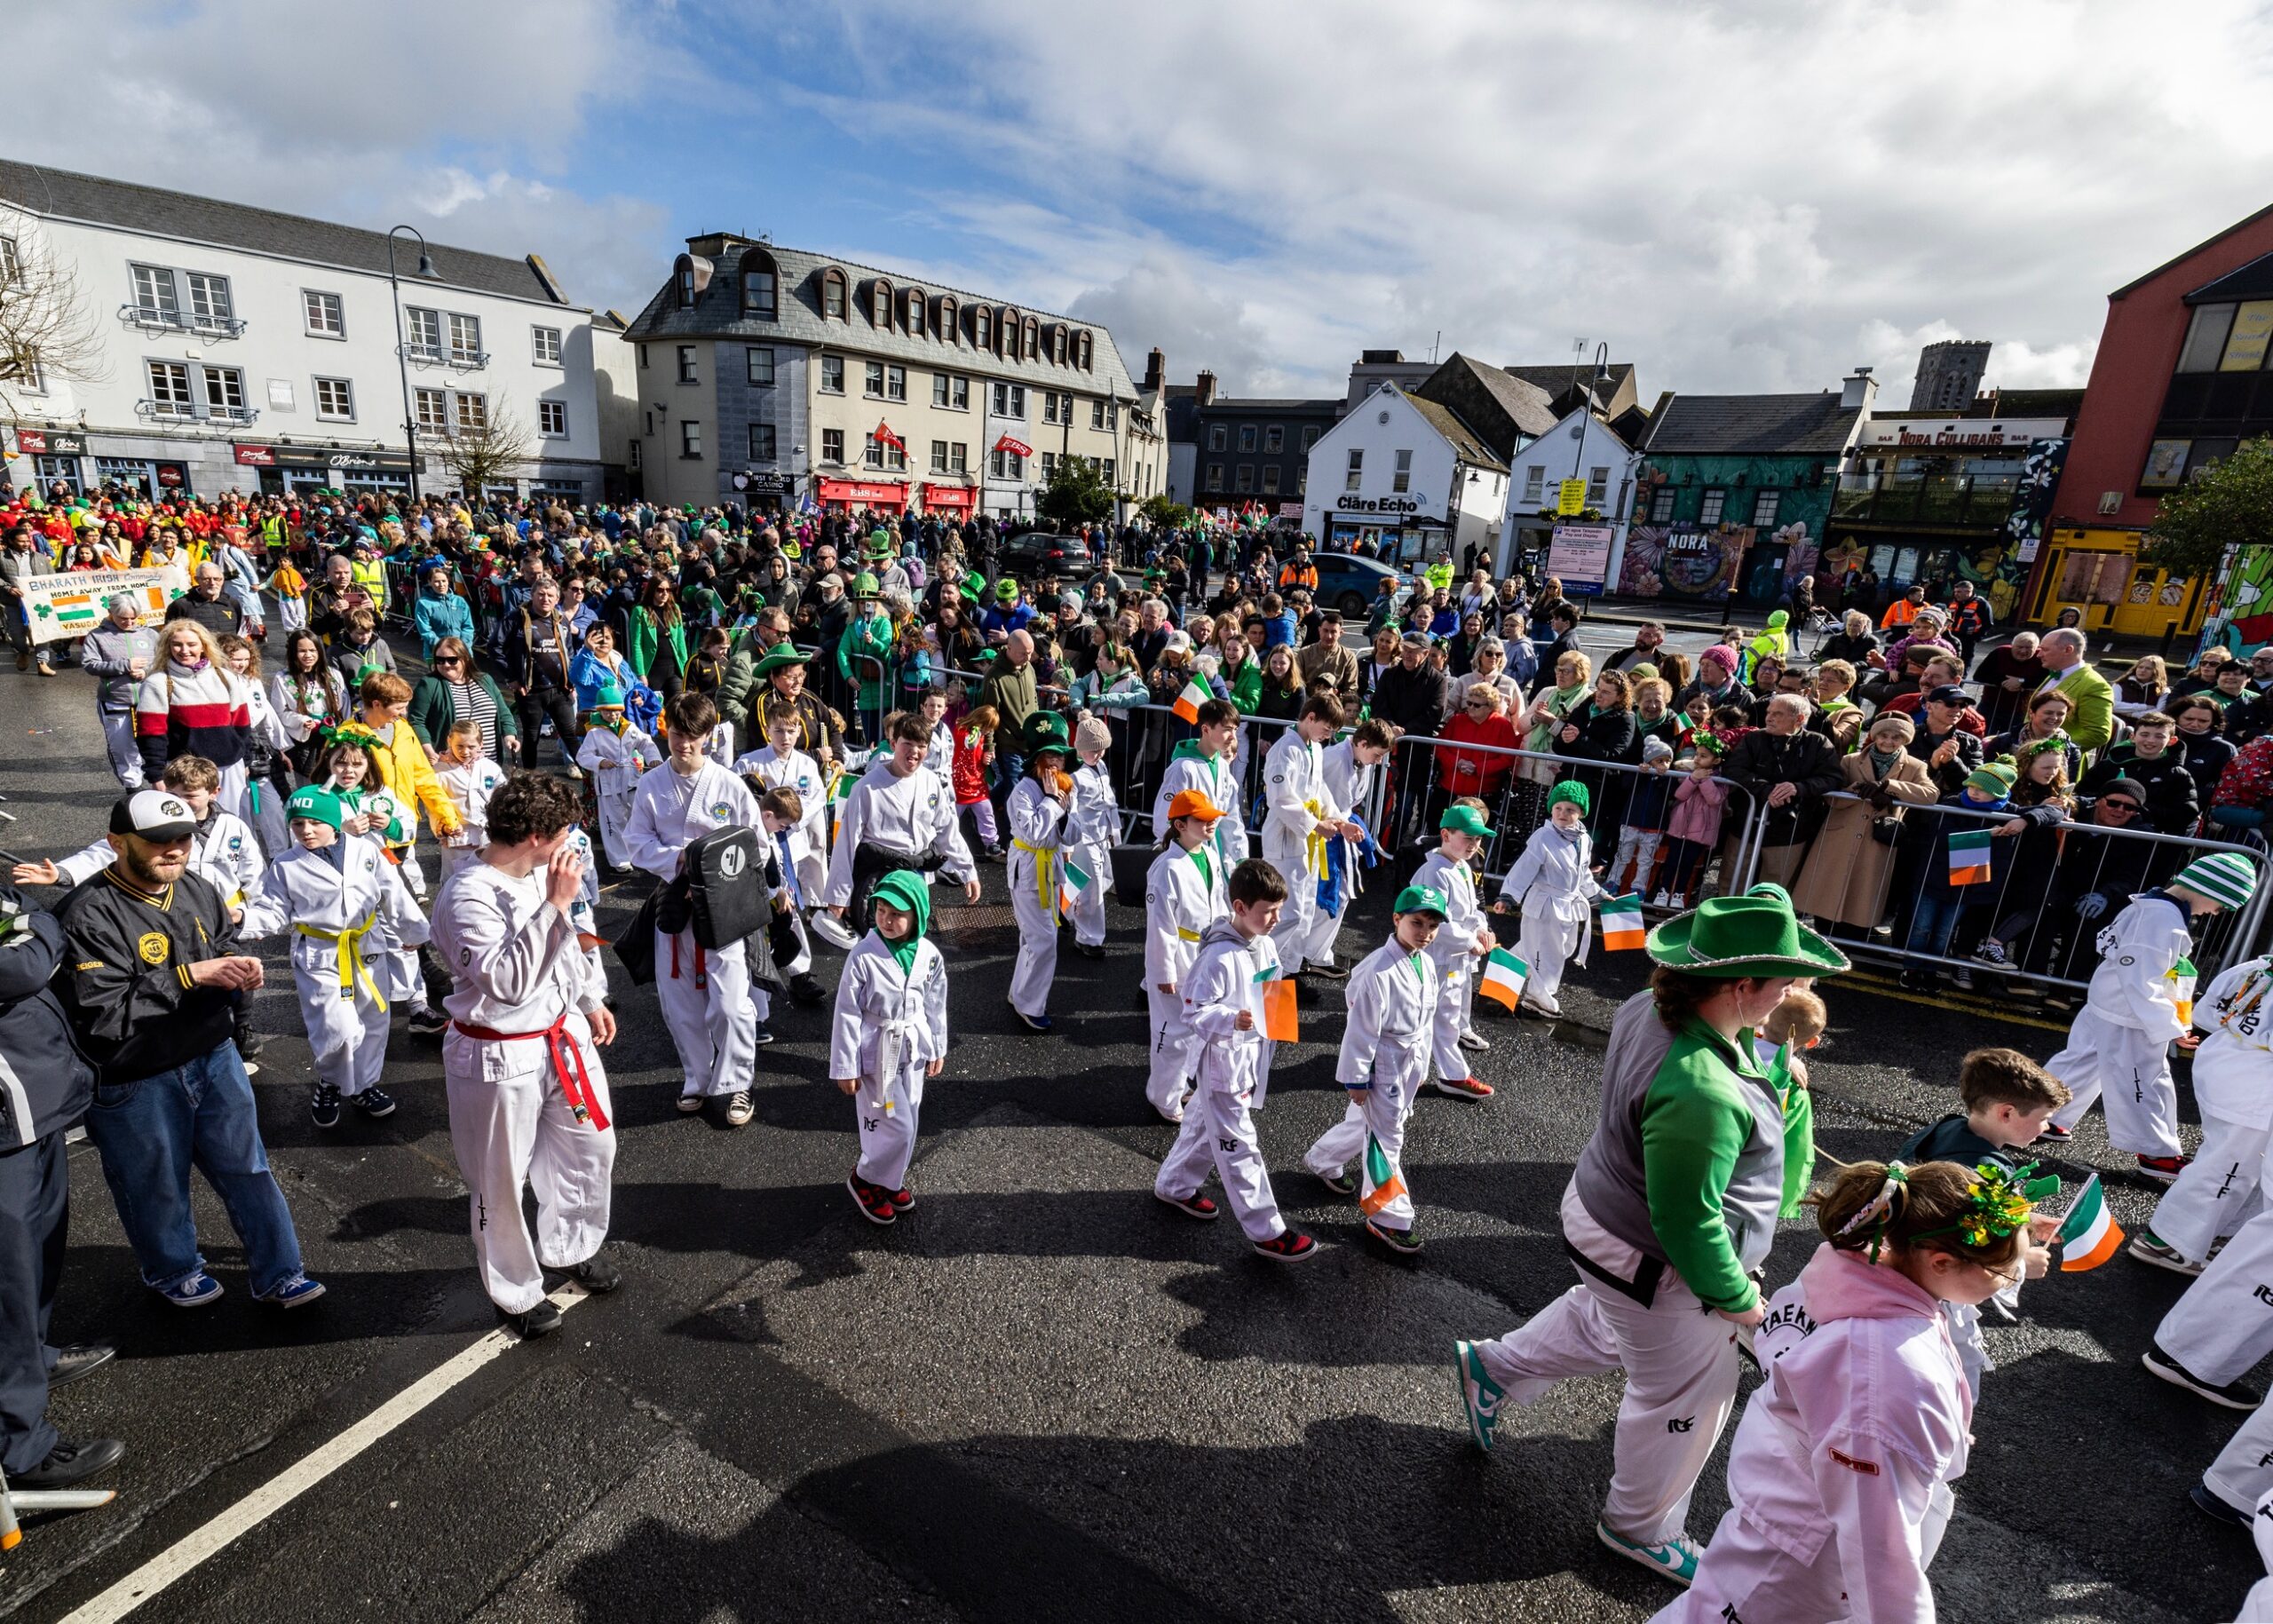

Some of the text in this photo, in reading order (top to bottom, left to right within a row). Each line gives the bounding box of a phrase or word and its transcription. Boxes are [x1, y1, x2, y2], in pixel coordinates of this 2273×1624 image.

[1898, 432, 2005, 445] NORA CULLIGANS
[1002, 439, 1027, 455] EBS
[850, 488, 870, 497] EBS
[1379, 497, 1417, 512] Echo
[1667, 534, 1708, 550] NORA
[29, 575, 87, 591] BHARATH
[91, 574, 119, 584] IRISH
[717, 870, 739, 882] bytomic
[1157, 1021, 1168, 1054] ITF
[2134, 1067, 2143, 1104] ITF
[2216, 1162, 2238, 1199] ITF
[478, 1193, 487, 1231] ITF
